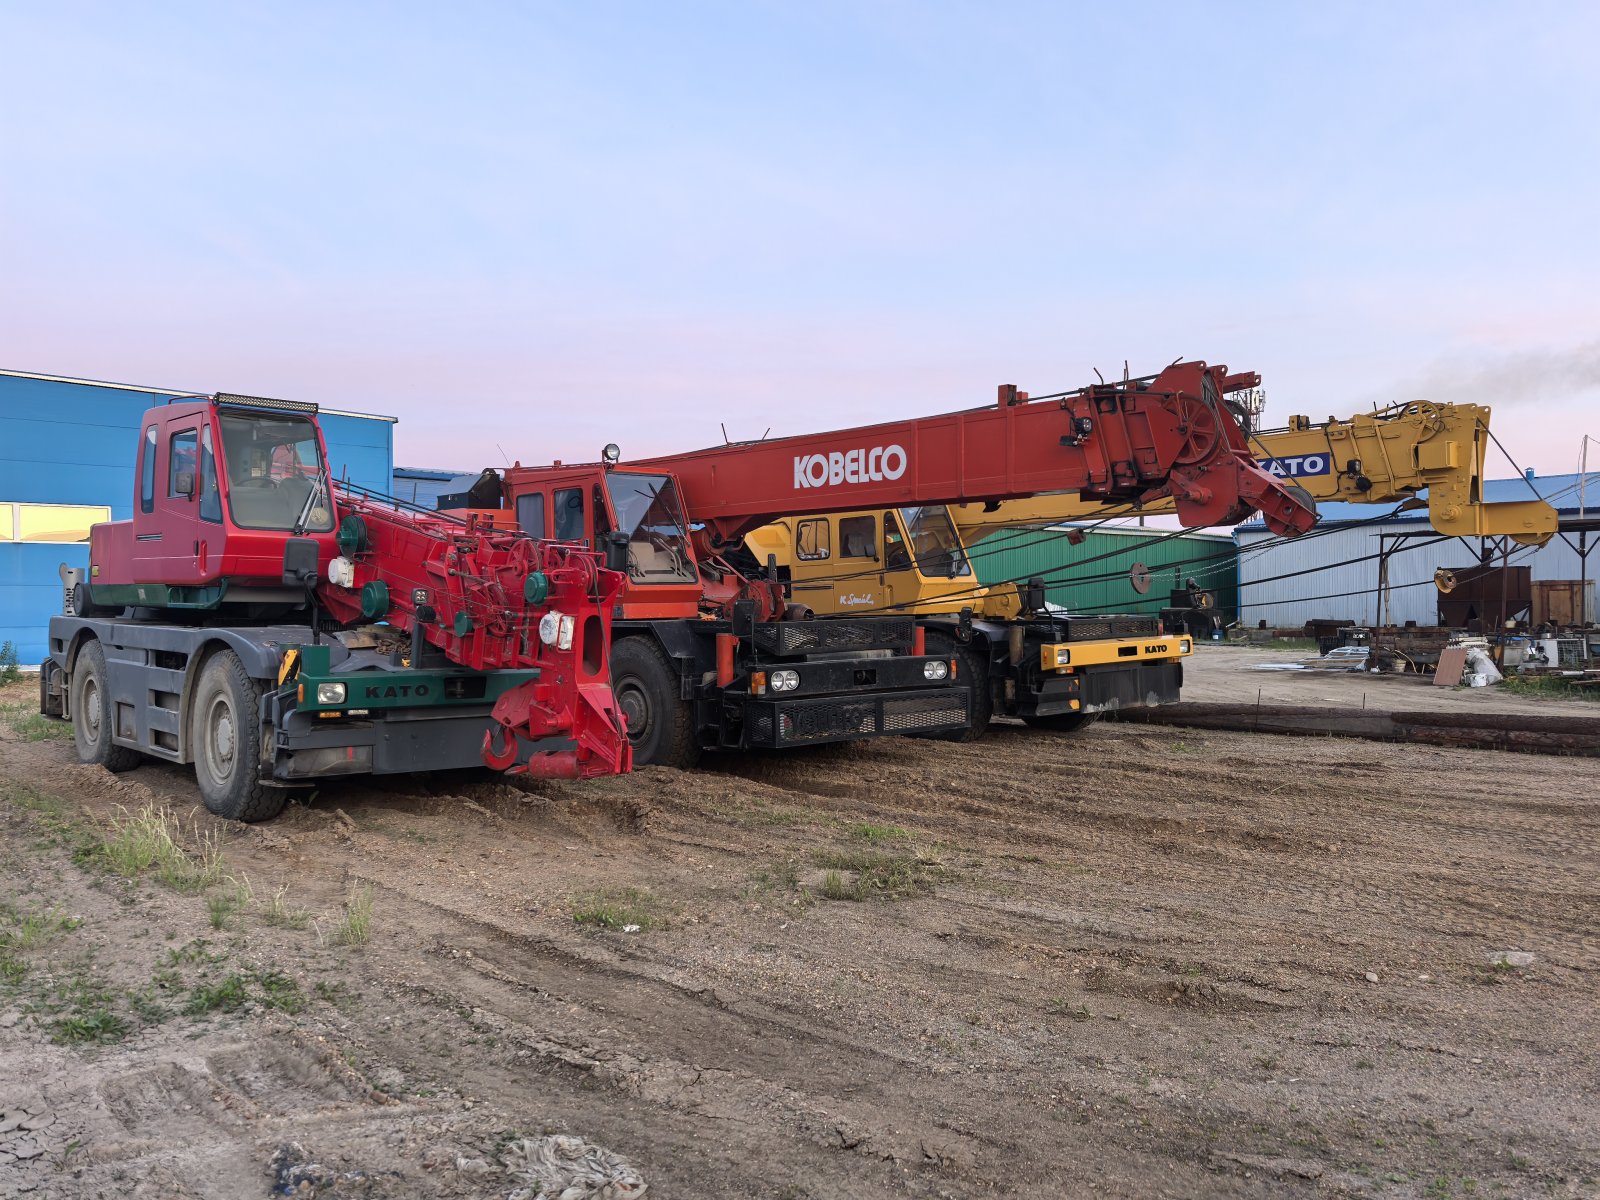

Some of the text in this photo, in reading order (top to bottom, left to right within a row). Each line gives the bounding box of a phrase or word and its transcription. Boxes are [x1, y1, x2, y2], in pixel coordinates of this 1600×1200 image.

[794, 444, 907, 489] KOBELCO
[1257, 456, 1324, 476] ATO
[1145, 645, 1167, 653] KATO
[366, 685, 429, 698] KATO
